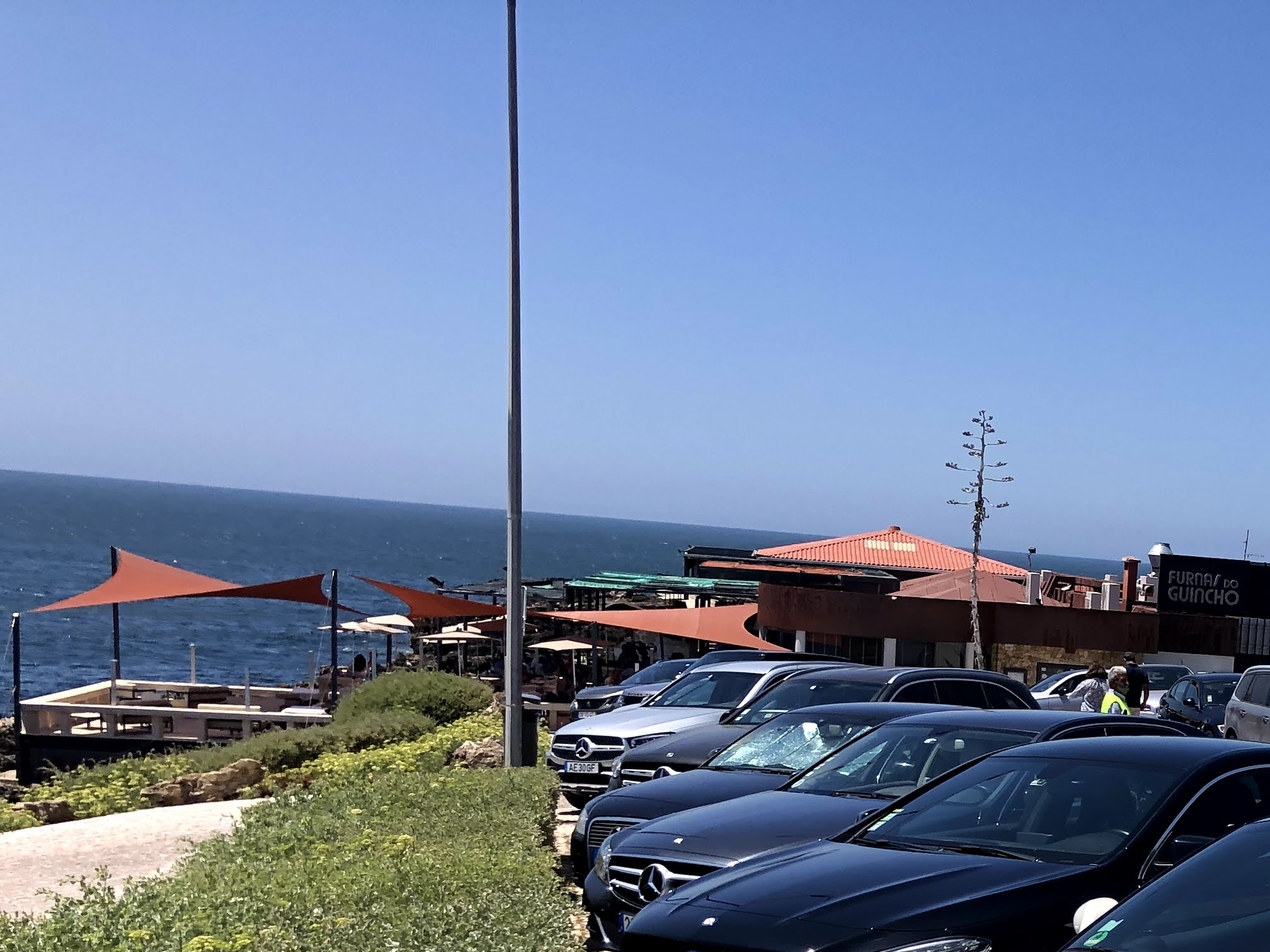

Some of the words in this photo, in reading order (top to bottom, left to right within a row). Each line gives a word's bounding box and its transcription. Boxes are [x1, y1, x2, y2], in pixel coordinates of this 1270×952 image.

[1168, 570, 1221, 587] FURNAS
[1223, 579, 1239, 588] DO
[1167, 586, 1240, 606] GUINCHO
